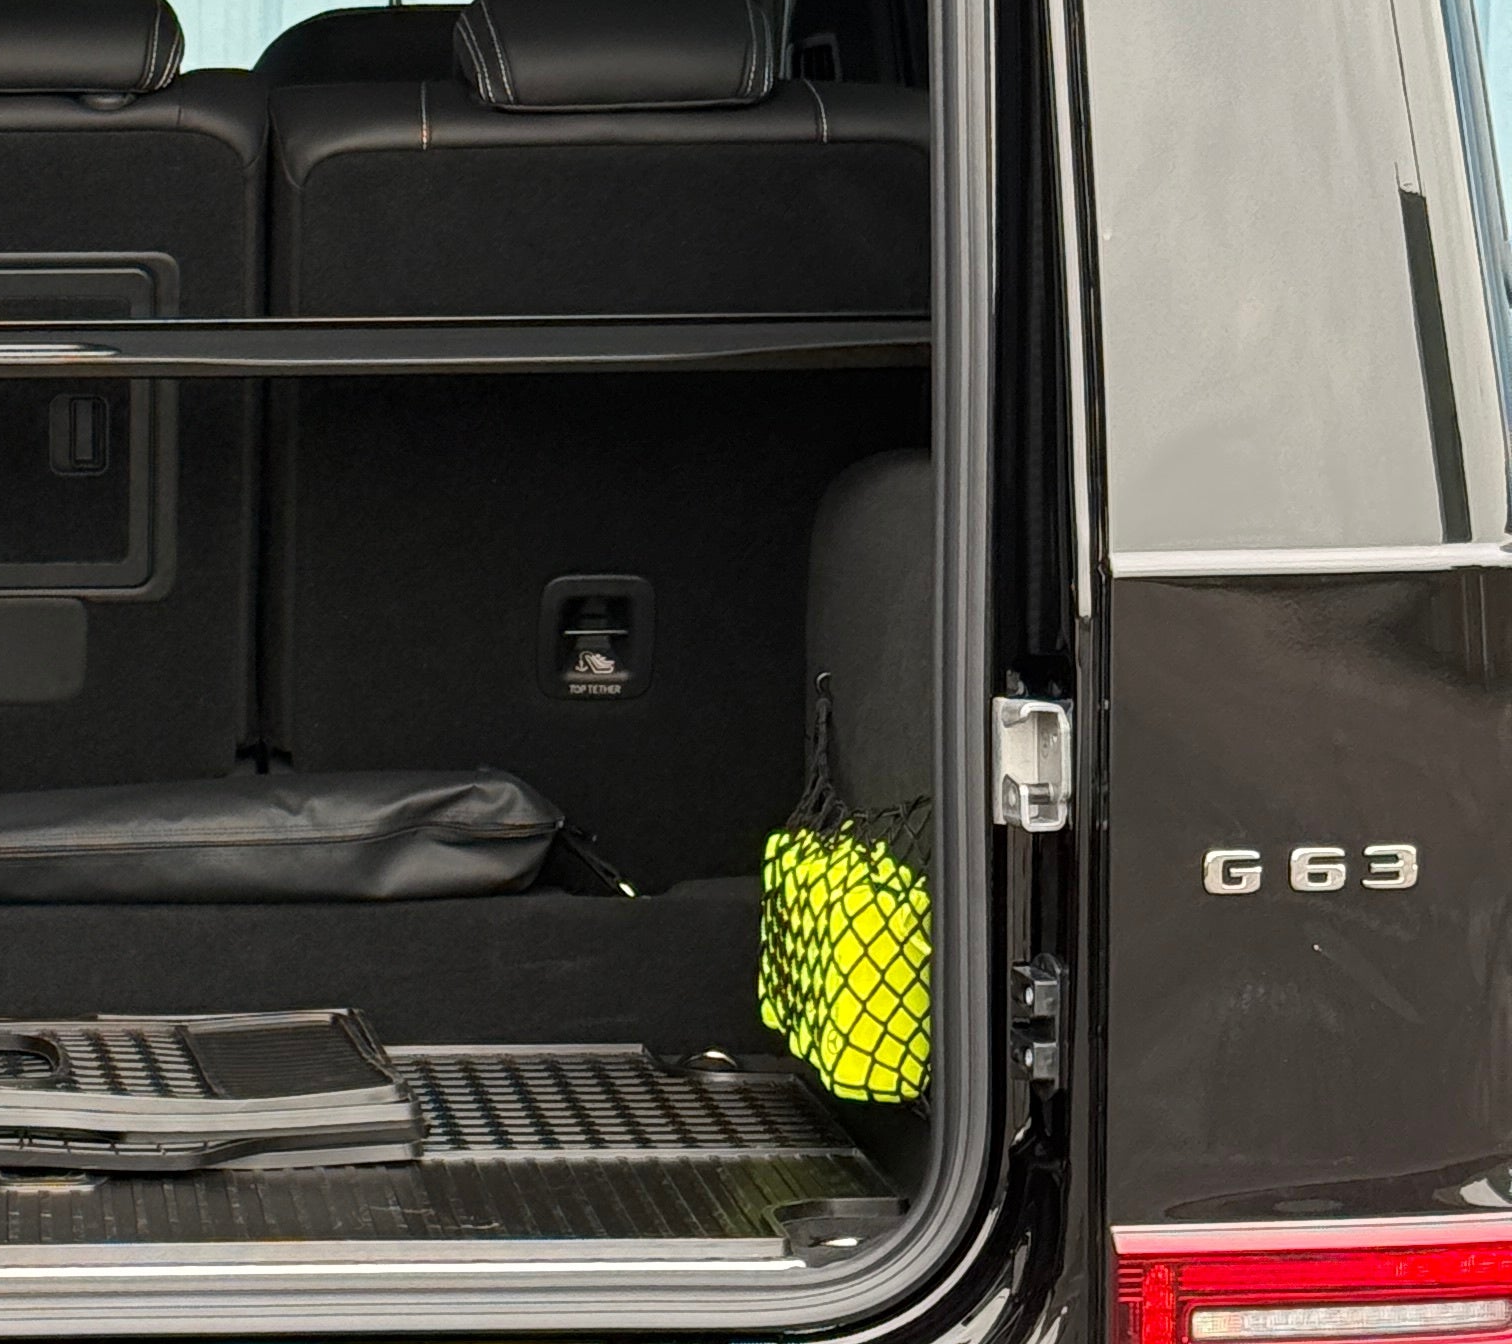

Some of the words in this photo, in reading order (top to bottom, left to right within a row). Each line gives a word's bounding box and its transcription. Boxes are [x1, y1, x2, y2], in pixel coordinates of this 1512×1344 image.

[569, 684, 587, 694] TOP
[588, 684, 621, 694] TETHER
[1204, 849, 1263, 895] G
[1290, 844, 1418, 892] 63
